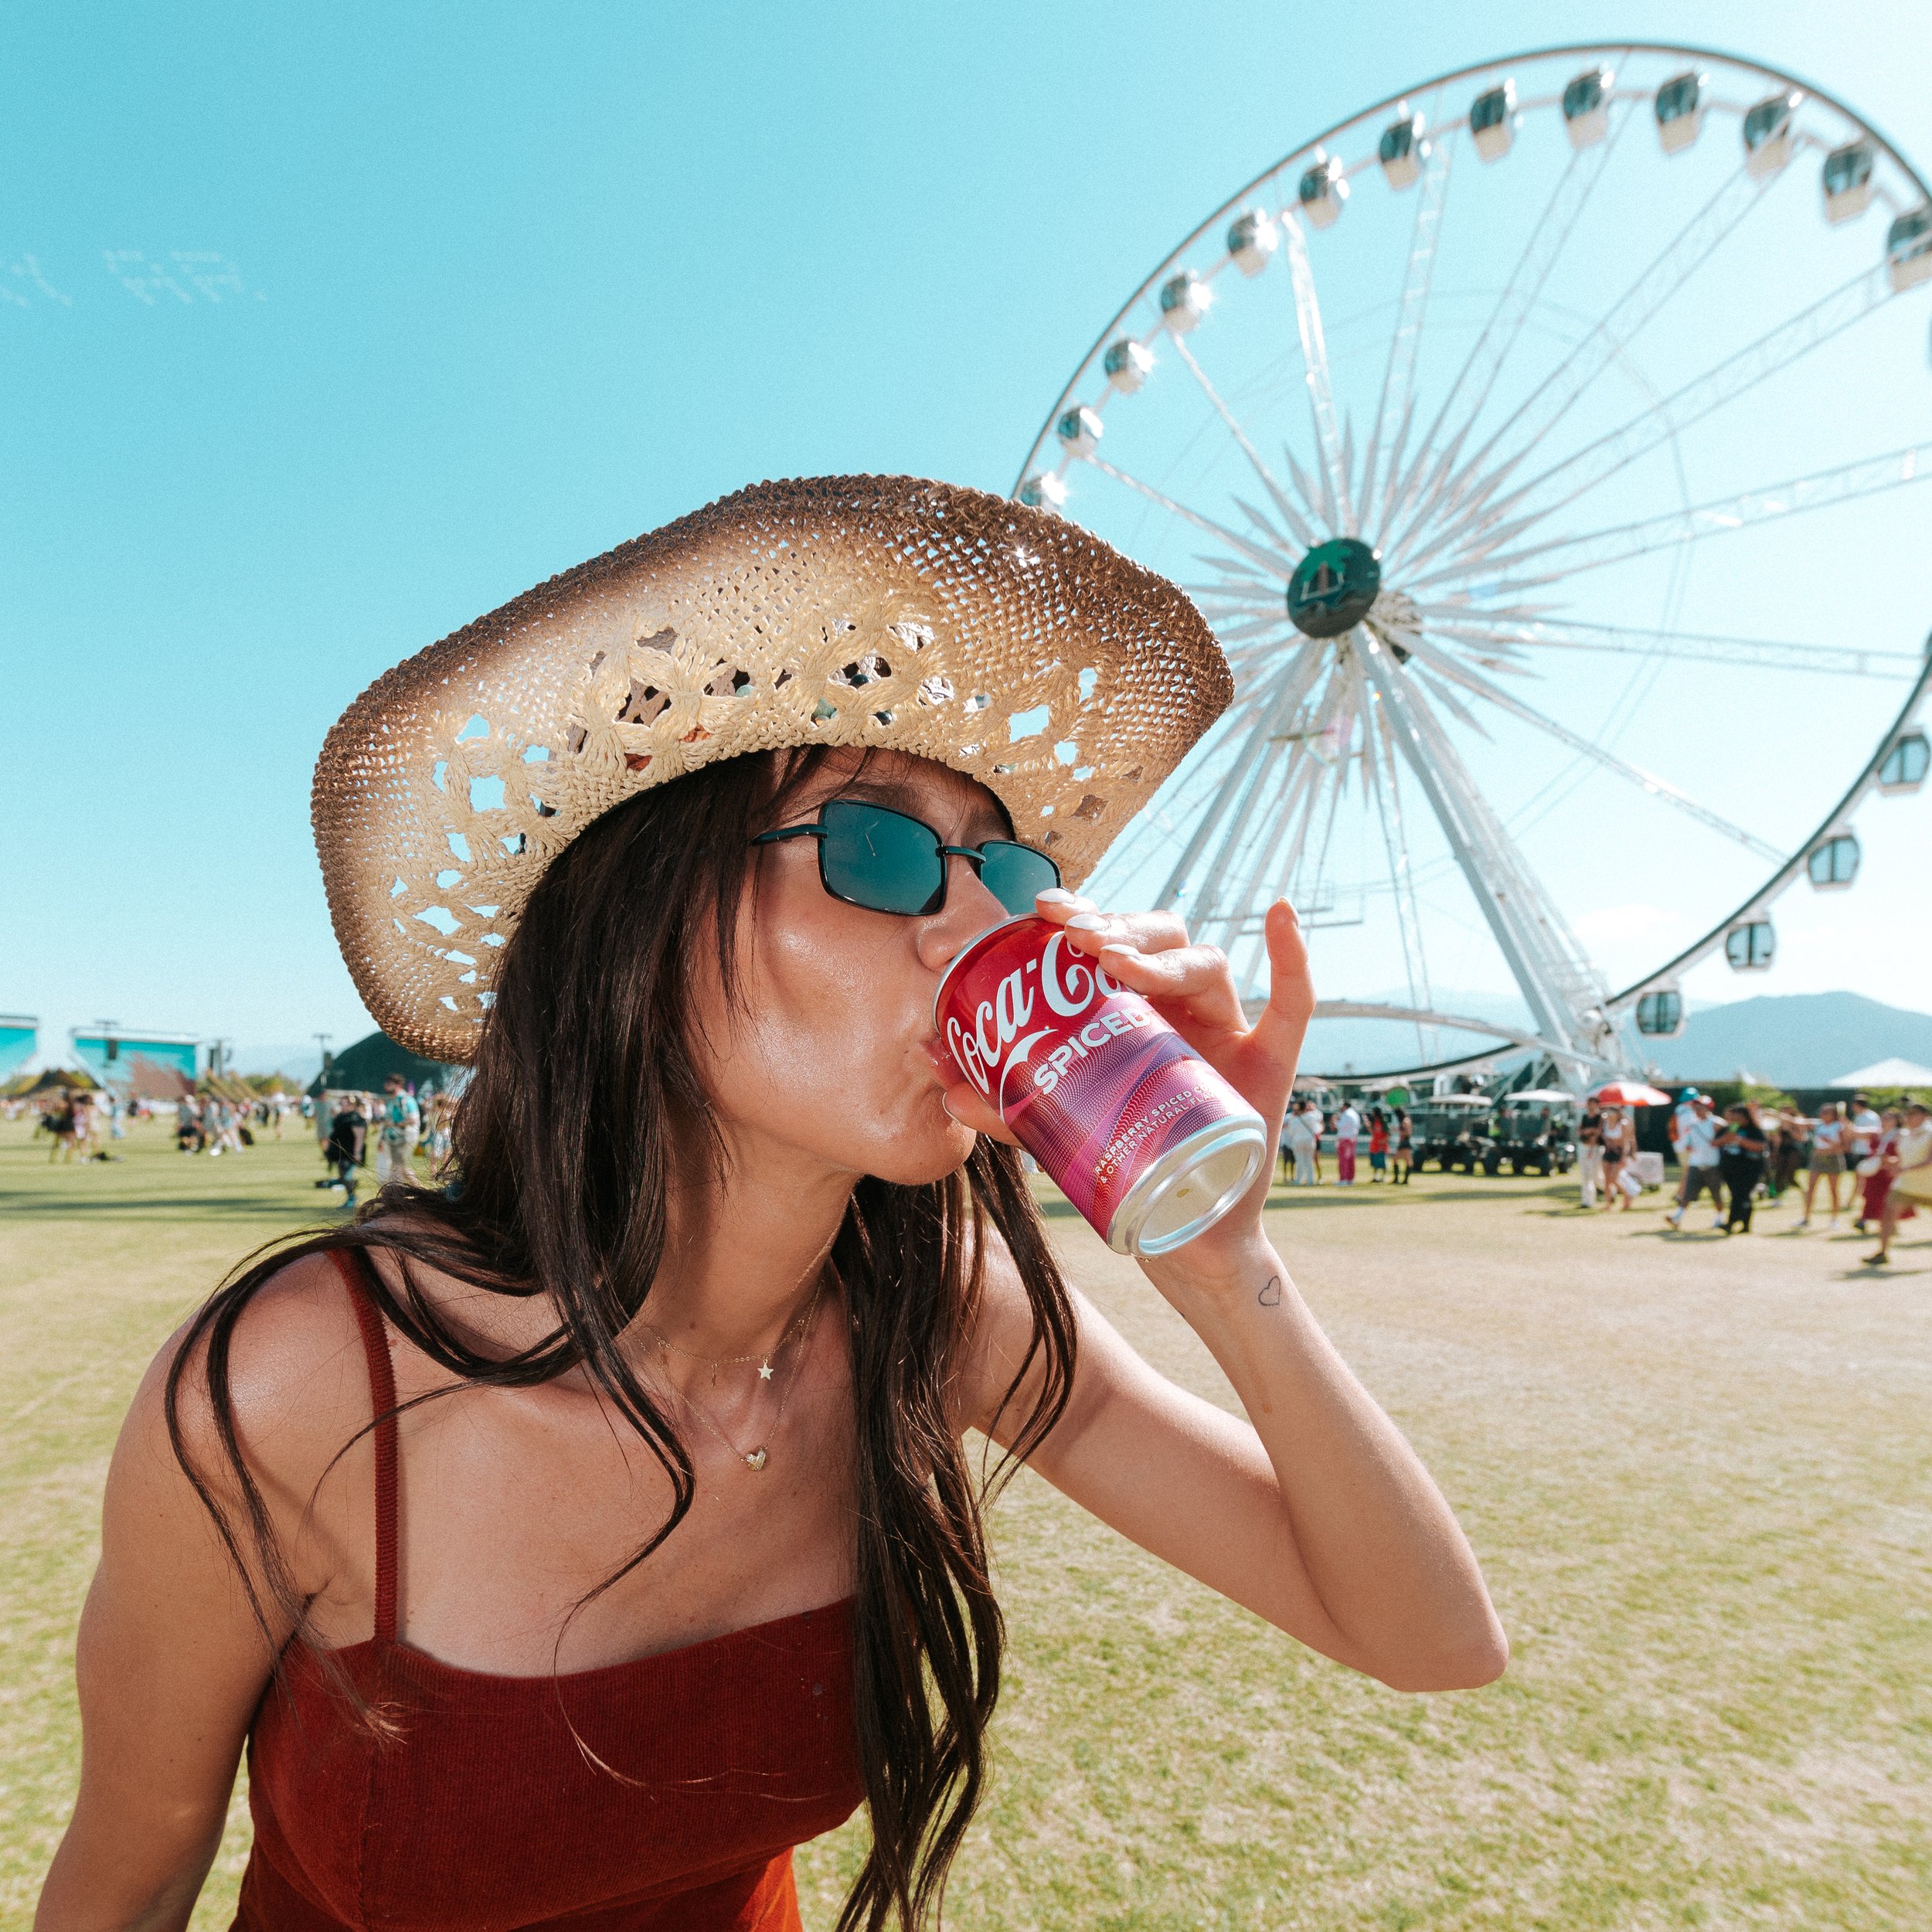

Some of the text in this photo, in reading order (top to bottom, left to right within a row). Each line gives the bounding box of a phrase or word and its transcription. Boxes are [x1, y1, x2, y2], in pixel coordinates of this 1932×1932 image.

[947, 930, 1138, 1099] Coca-Co
[1034, 1008, 1151, 1095] SPICED
[1094, 1115, 1149, 1175] RASPBERRY
[1151, 1090, 1192, 1117] SPICED
[1107, 1140, 1138, 1174] OTHER
[1138, 1104, 1189, 1141] NATURAL
[1189, 1090, 1216, 1106] FLA
